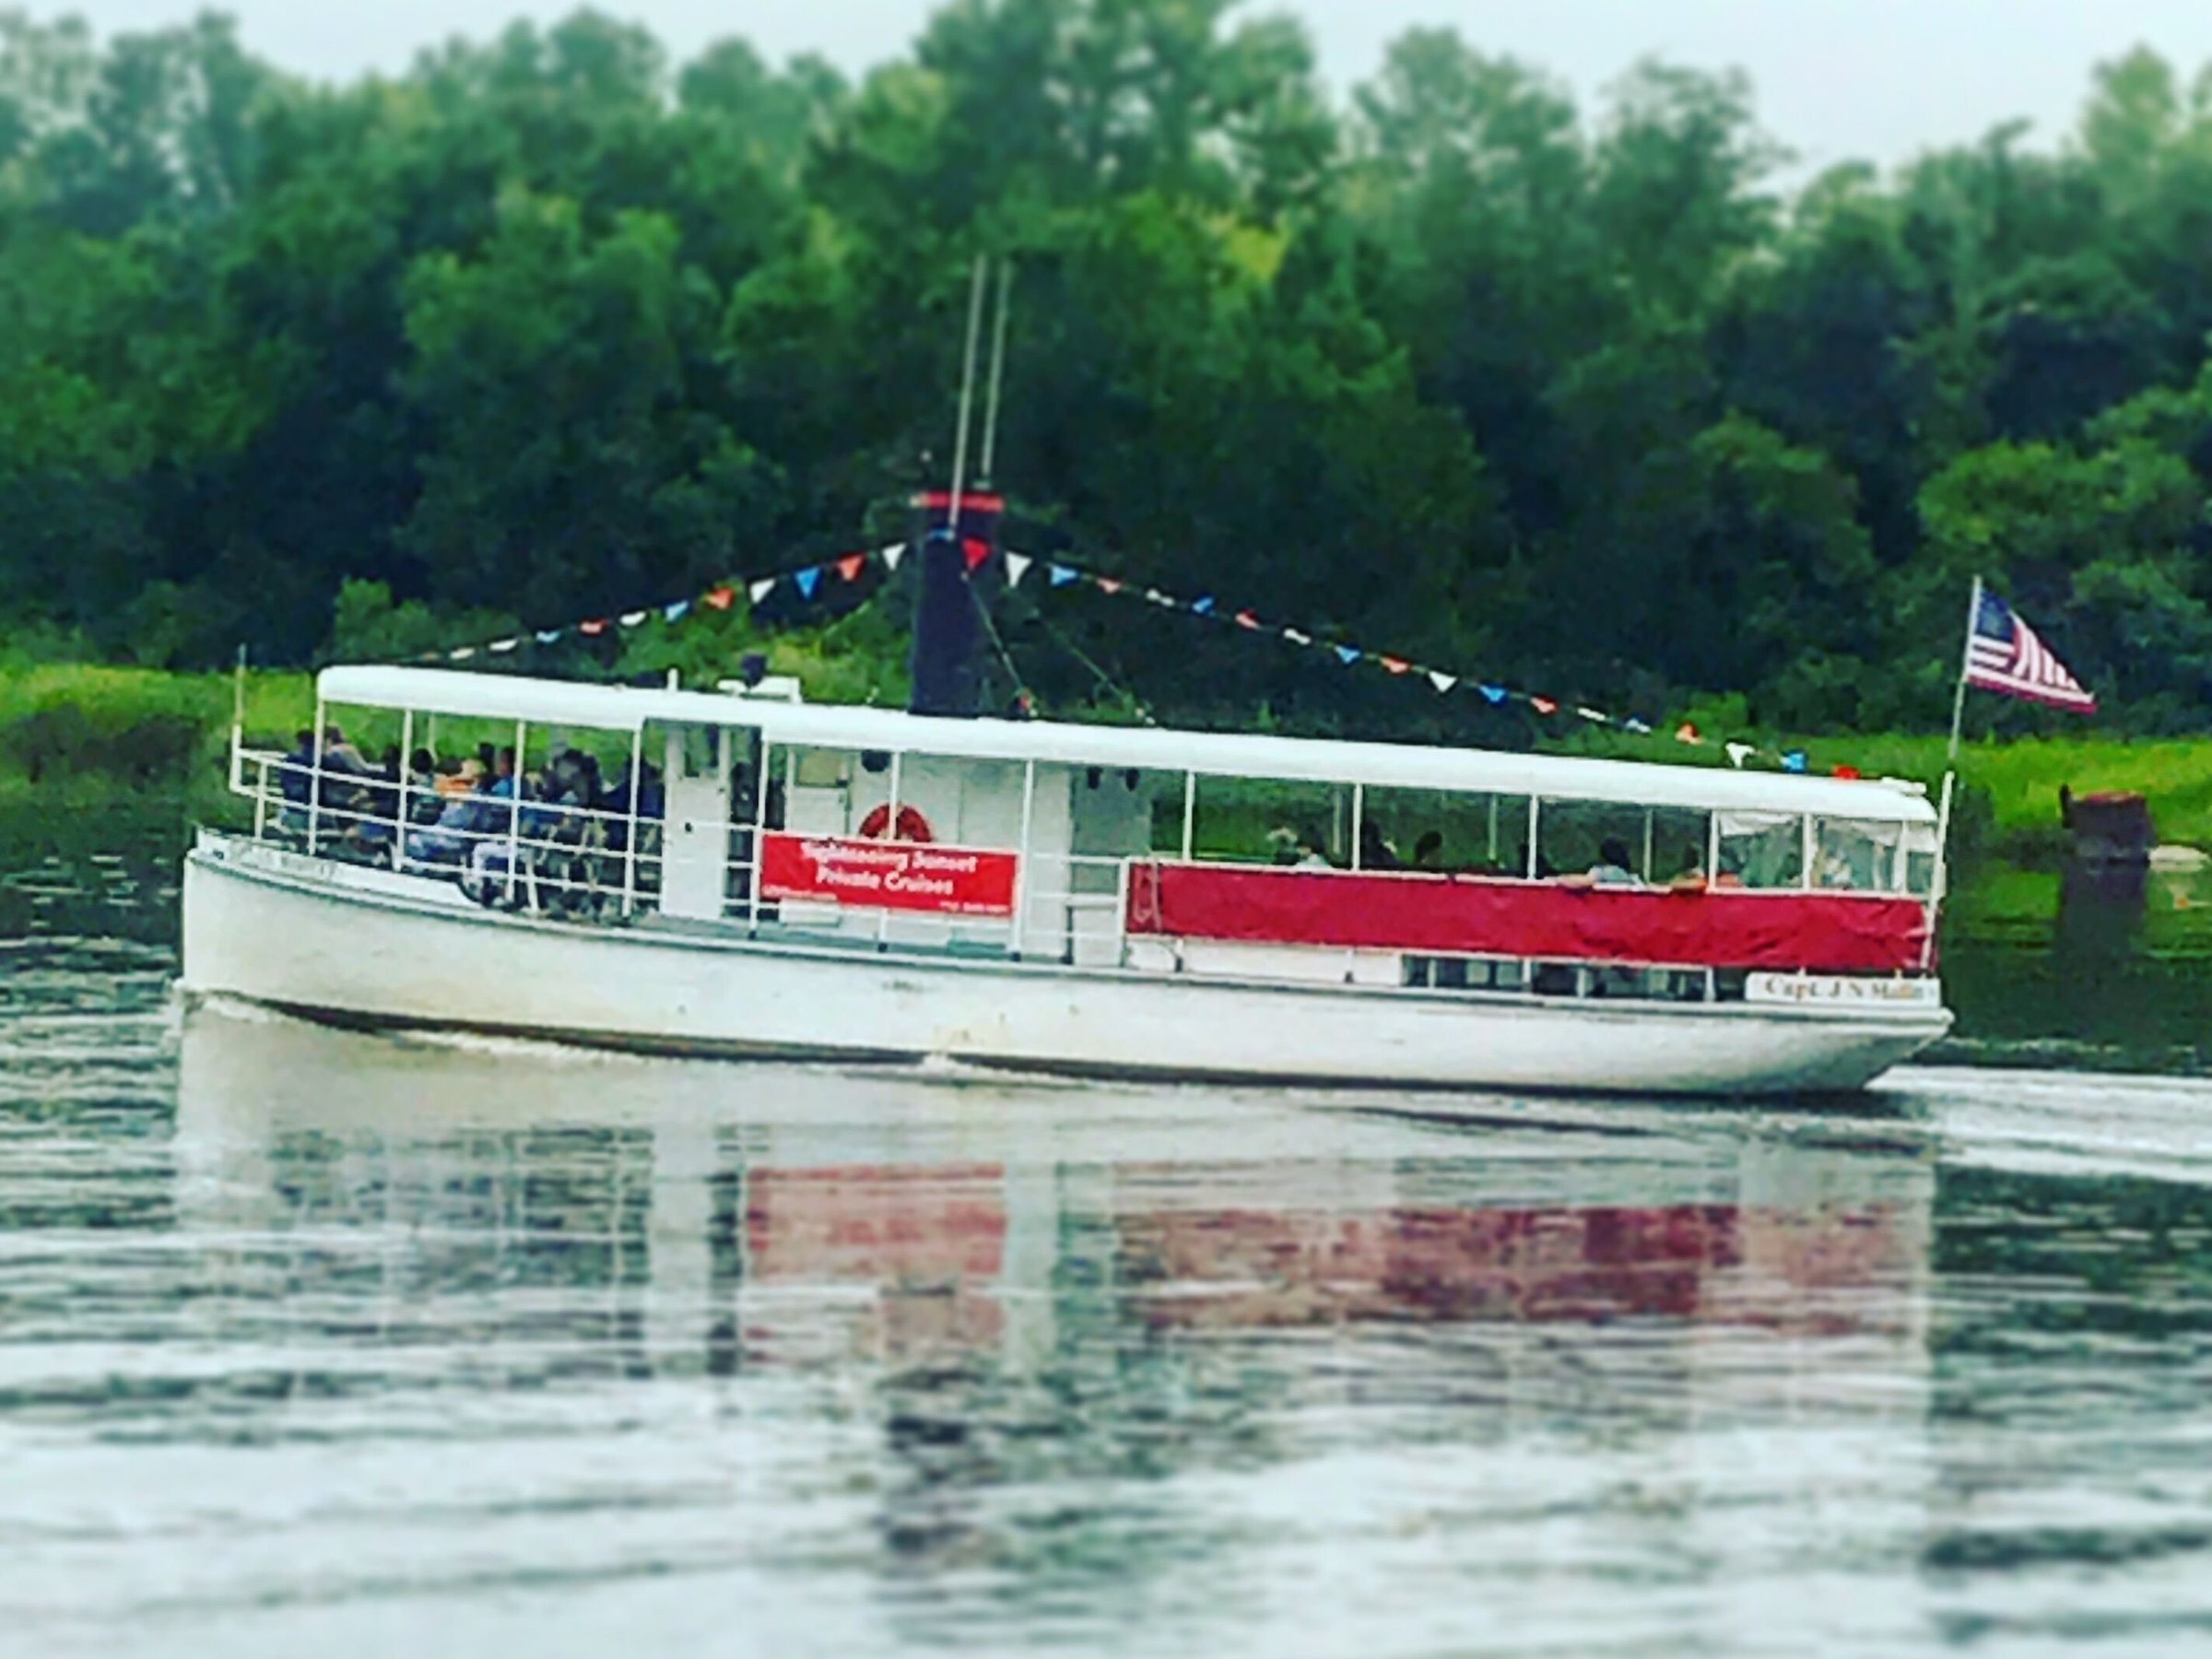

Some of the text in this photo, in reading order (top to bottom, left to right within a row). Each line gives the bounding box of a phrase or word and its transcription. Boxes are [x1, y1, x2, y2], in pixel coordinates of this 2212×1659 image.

[913, 852, 977, 872] Sunset
[816, 868, 953, 894] Private Cruises
[1829, 981, 1841, 998] J
